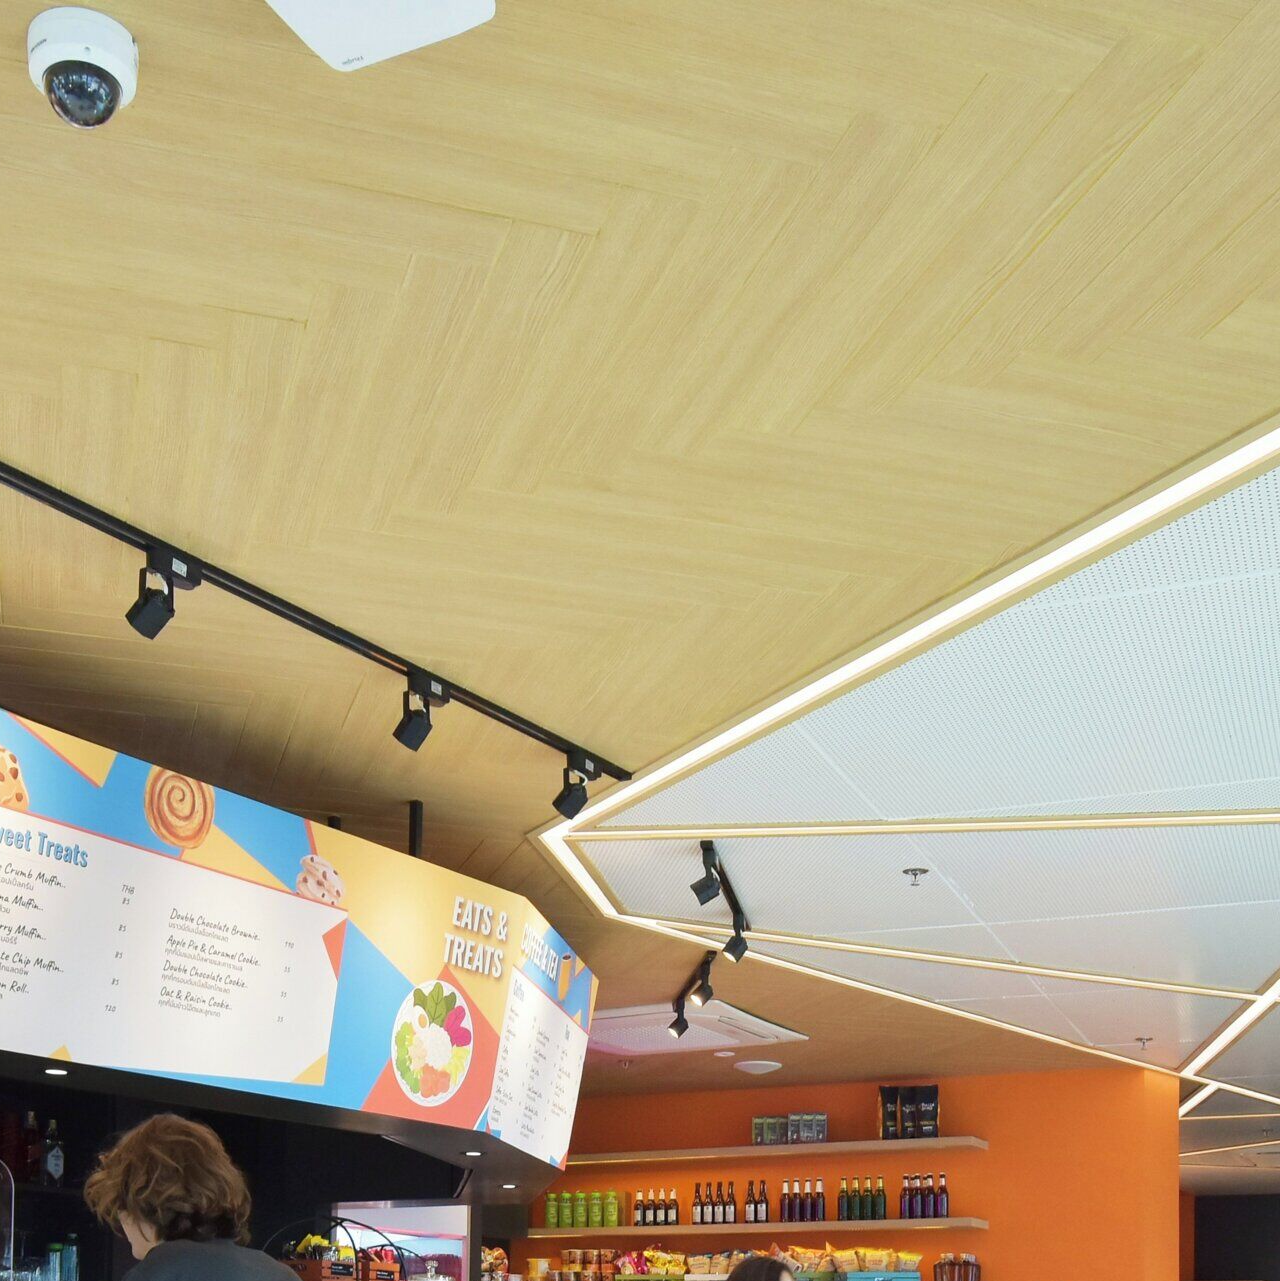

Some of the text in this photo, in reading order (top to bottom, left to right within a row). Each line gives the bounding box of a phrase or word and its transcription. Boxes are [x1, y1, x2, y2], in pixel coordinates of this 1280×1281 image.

[38, 832, 88, 868] Treats
[4, 862, 33, 879] Crumb
[169, 908, 195, 923] Double
[196, 916, 230, 933] Chocolate
[452, 896, 508, 941] EATS &
[12, 952, 30, 967] Chip
[166, 934, 186, 949] Apple
[187, 940, 199, 951] Pie
[200, 943, 206, 953] &
[208, 945, 237, 960] Caramel
[443, 933, 505, 978] TREATS
[163, 960, 188, 975] Double
[189, 966, 223, 983] Chocolate
[546, 948, 559, 981] TEA
[160, 986, 174, 997] Oat
[176, 989, 182, 1000] &
[184, 992, 206, 1005] Raisin
